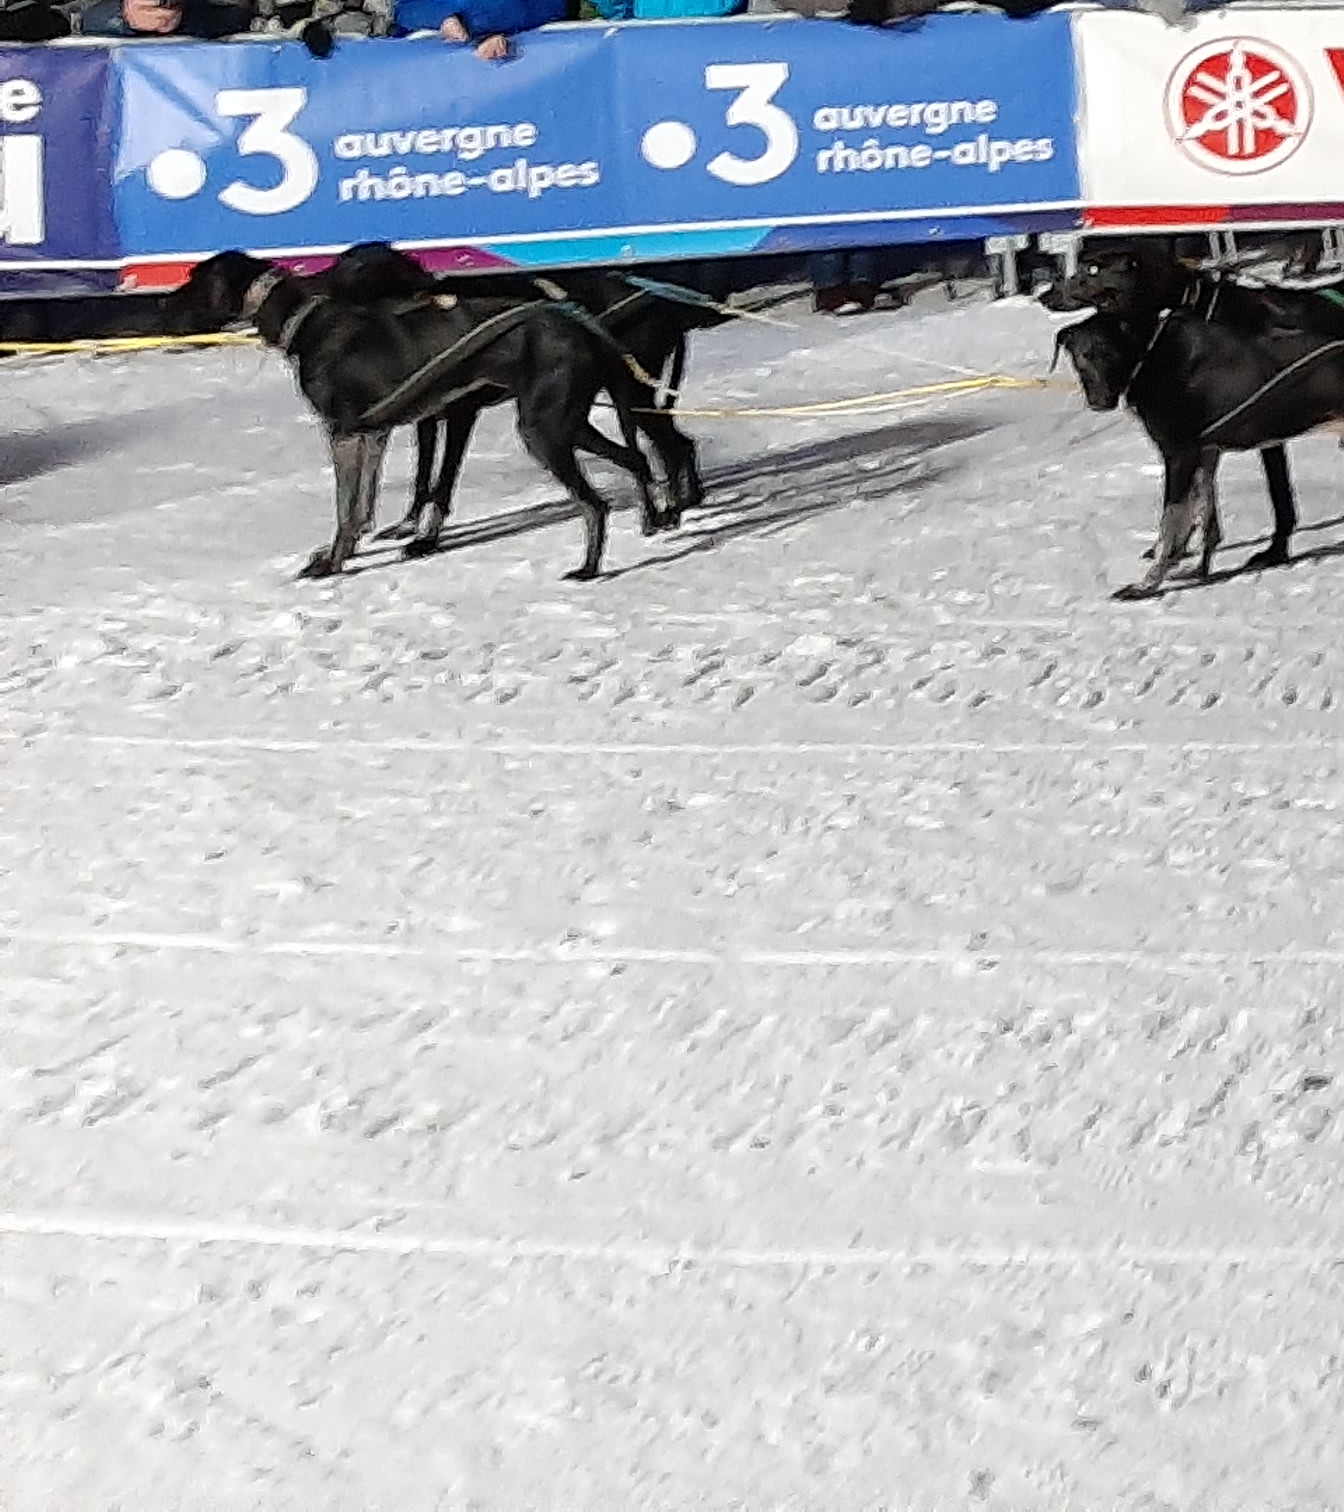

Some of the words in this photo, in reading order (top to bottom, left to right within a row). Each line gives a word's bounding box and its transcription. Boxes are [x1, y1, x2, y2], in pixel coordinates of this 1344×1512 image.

[813, 99, 998, 135] auvergne
[334, 122, 539, 159] auvergne
[816, 133, 1054, 173] rhône-alpes
[338, 157, 599, 202] rhône-alpes
